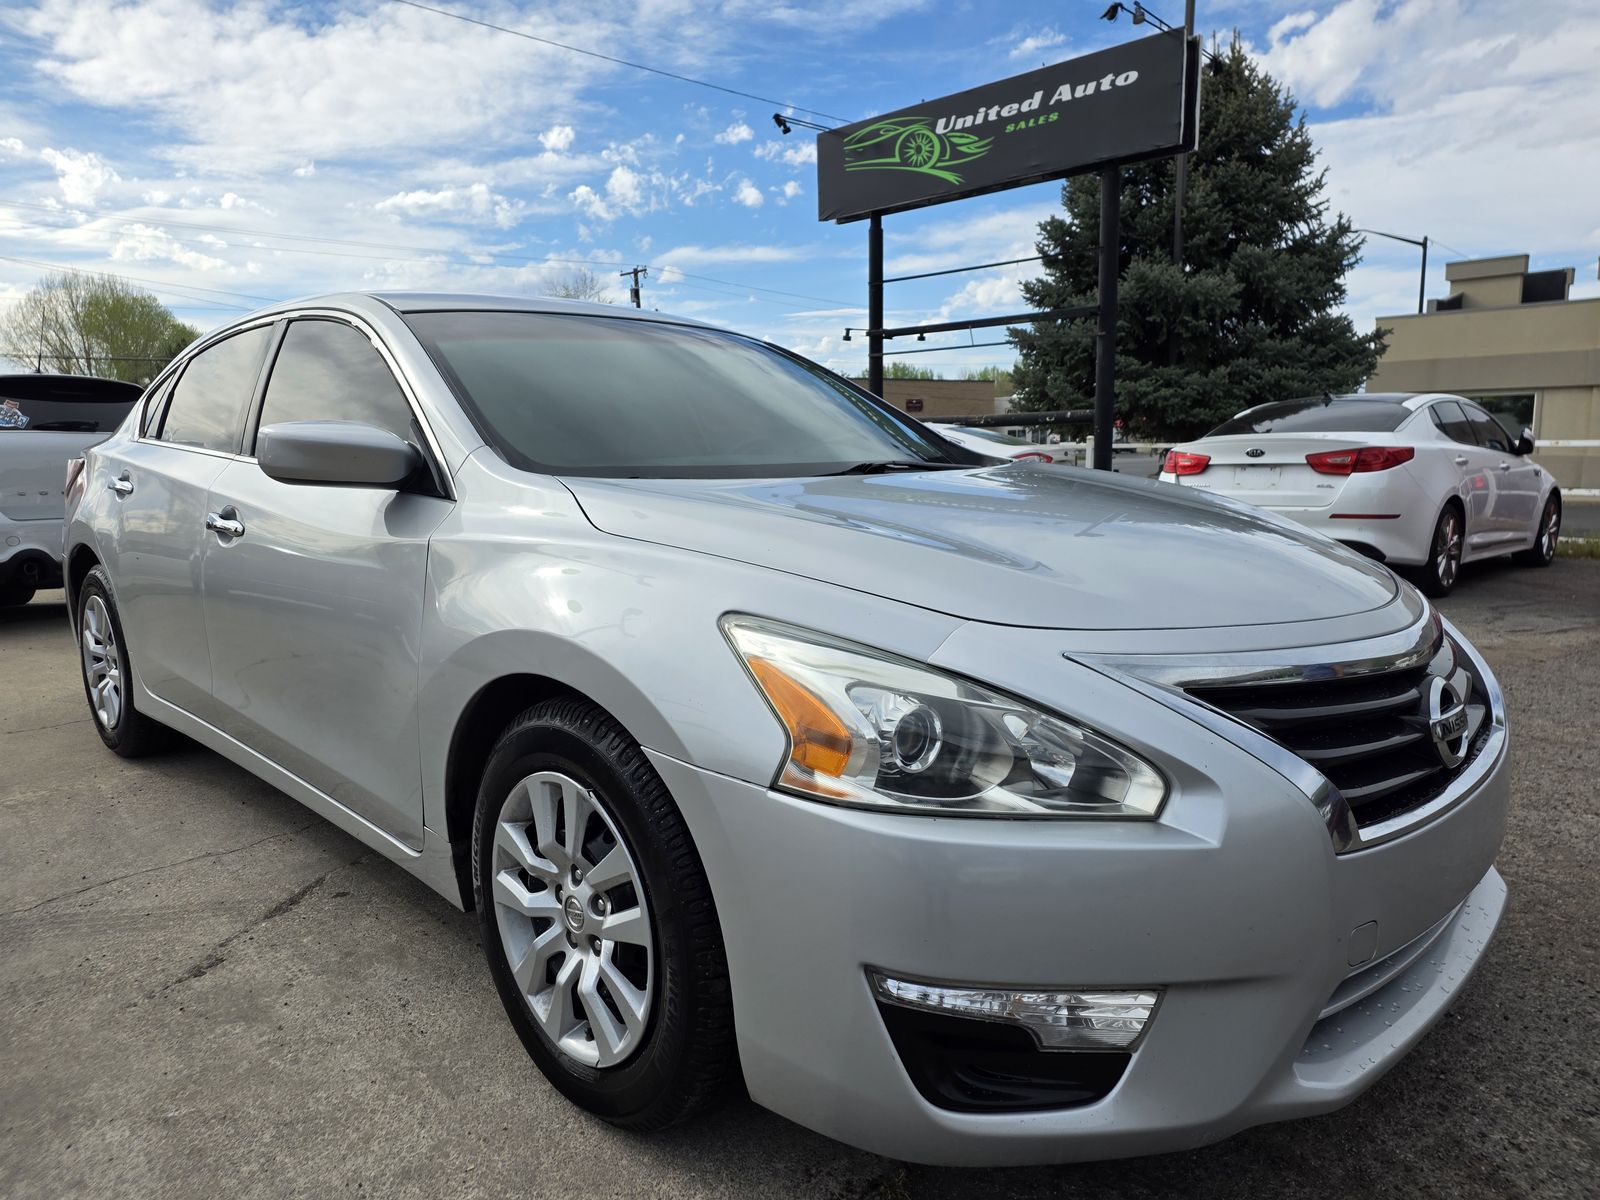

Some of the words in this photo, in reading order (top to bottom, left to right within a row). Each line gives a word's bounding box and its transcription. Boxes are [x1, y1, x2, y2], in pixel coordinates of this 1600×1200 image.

[935, 90, 1044, 134] United
[1049, 70, 1139, 105] Auto
[1005, 112, 1060, 133] SALES
